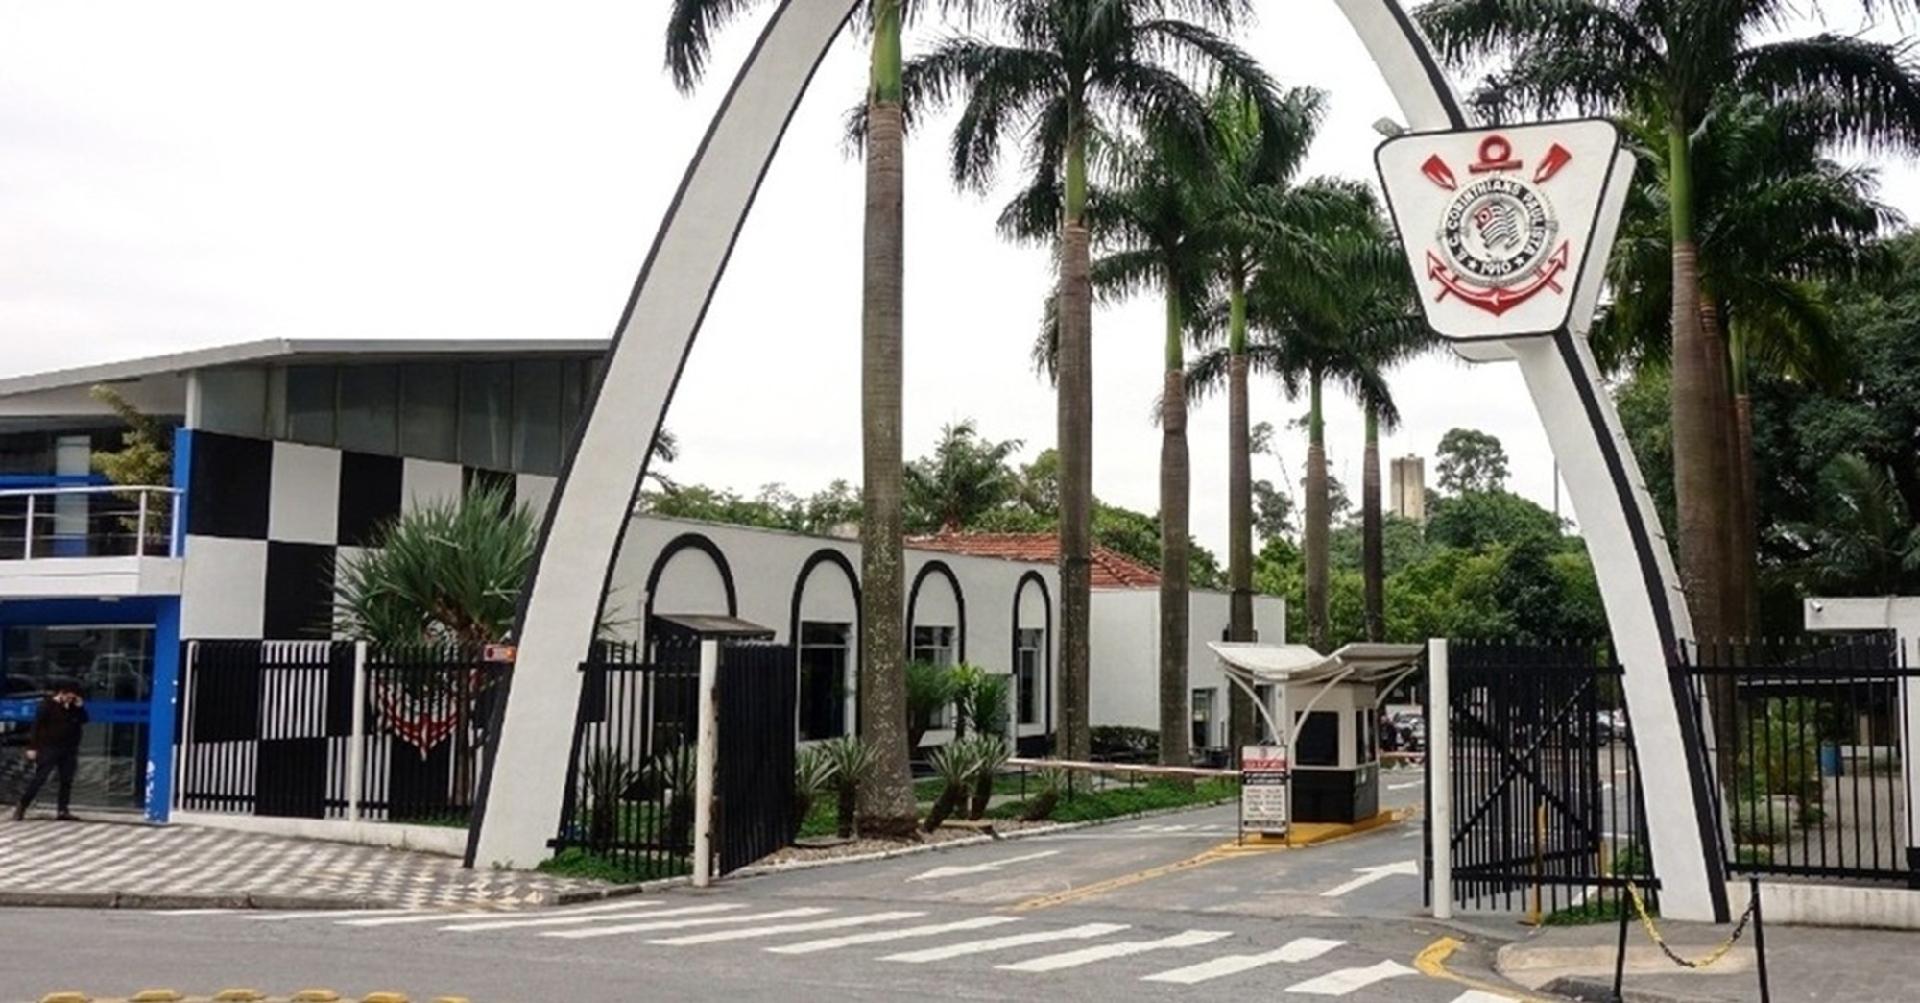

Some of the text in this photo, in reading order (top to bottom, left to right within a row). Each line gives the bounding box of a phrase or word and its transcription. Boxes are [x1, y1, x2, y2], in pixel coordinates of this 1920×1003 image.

[1448, 180, 1522, 230] CORINTHIANS
[1523, 193, 1545, 256] PAULISTA
[1481, 262, 1511, 274] 1910
